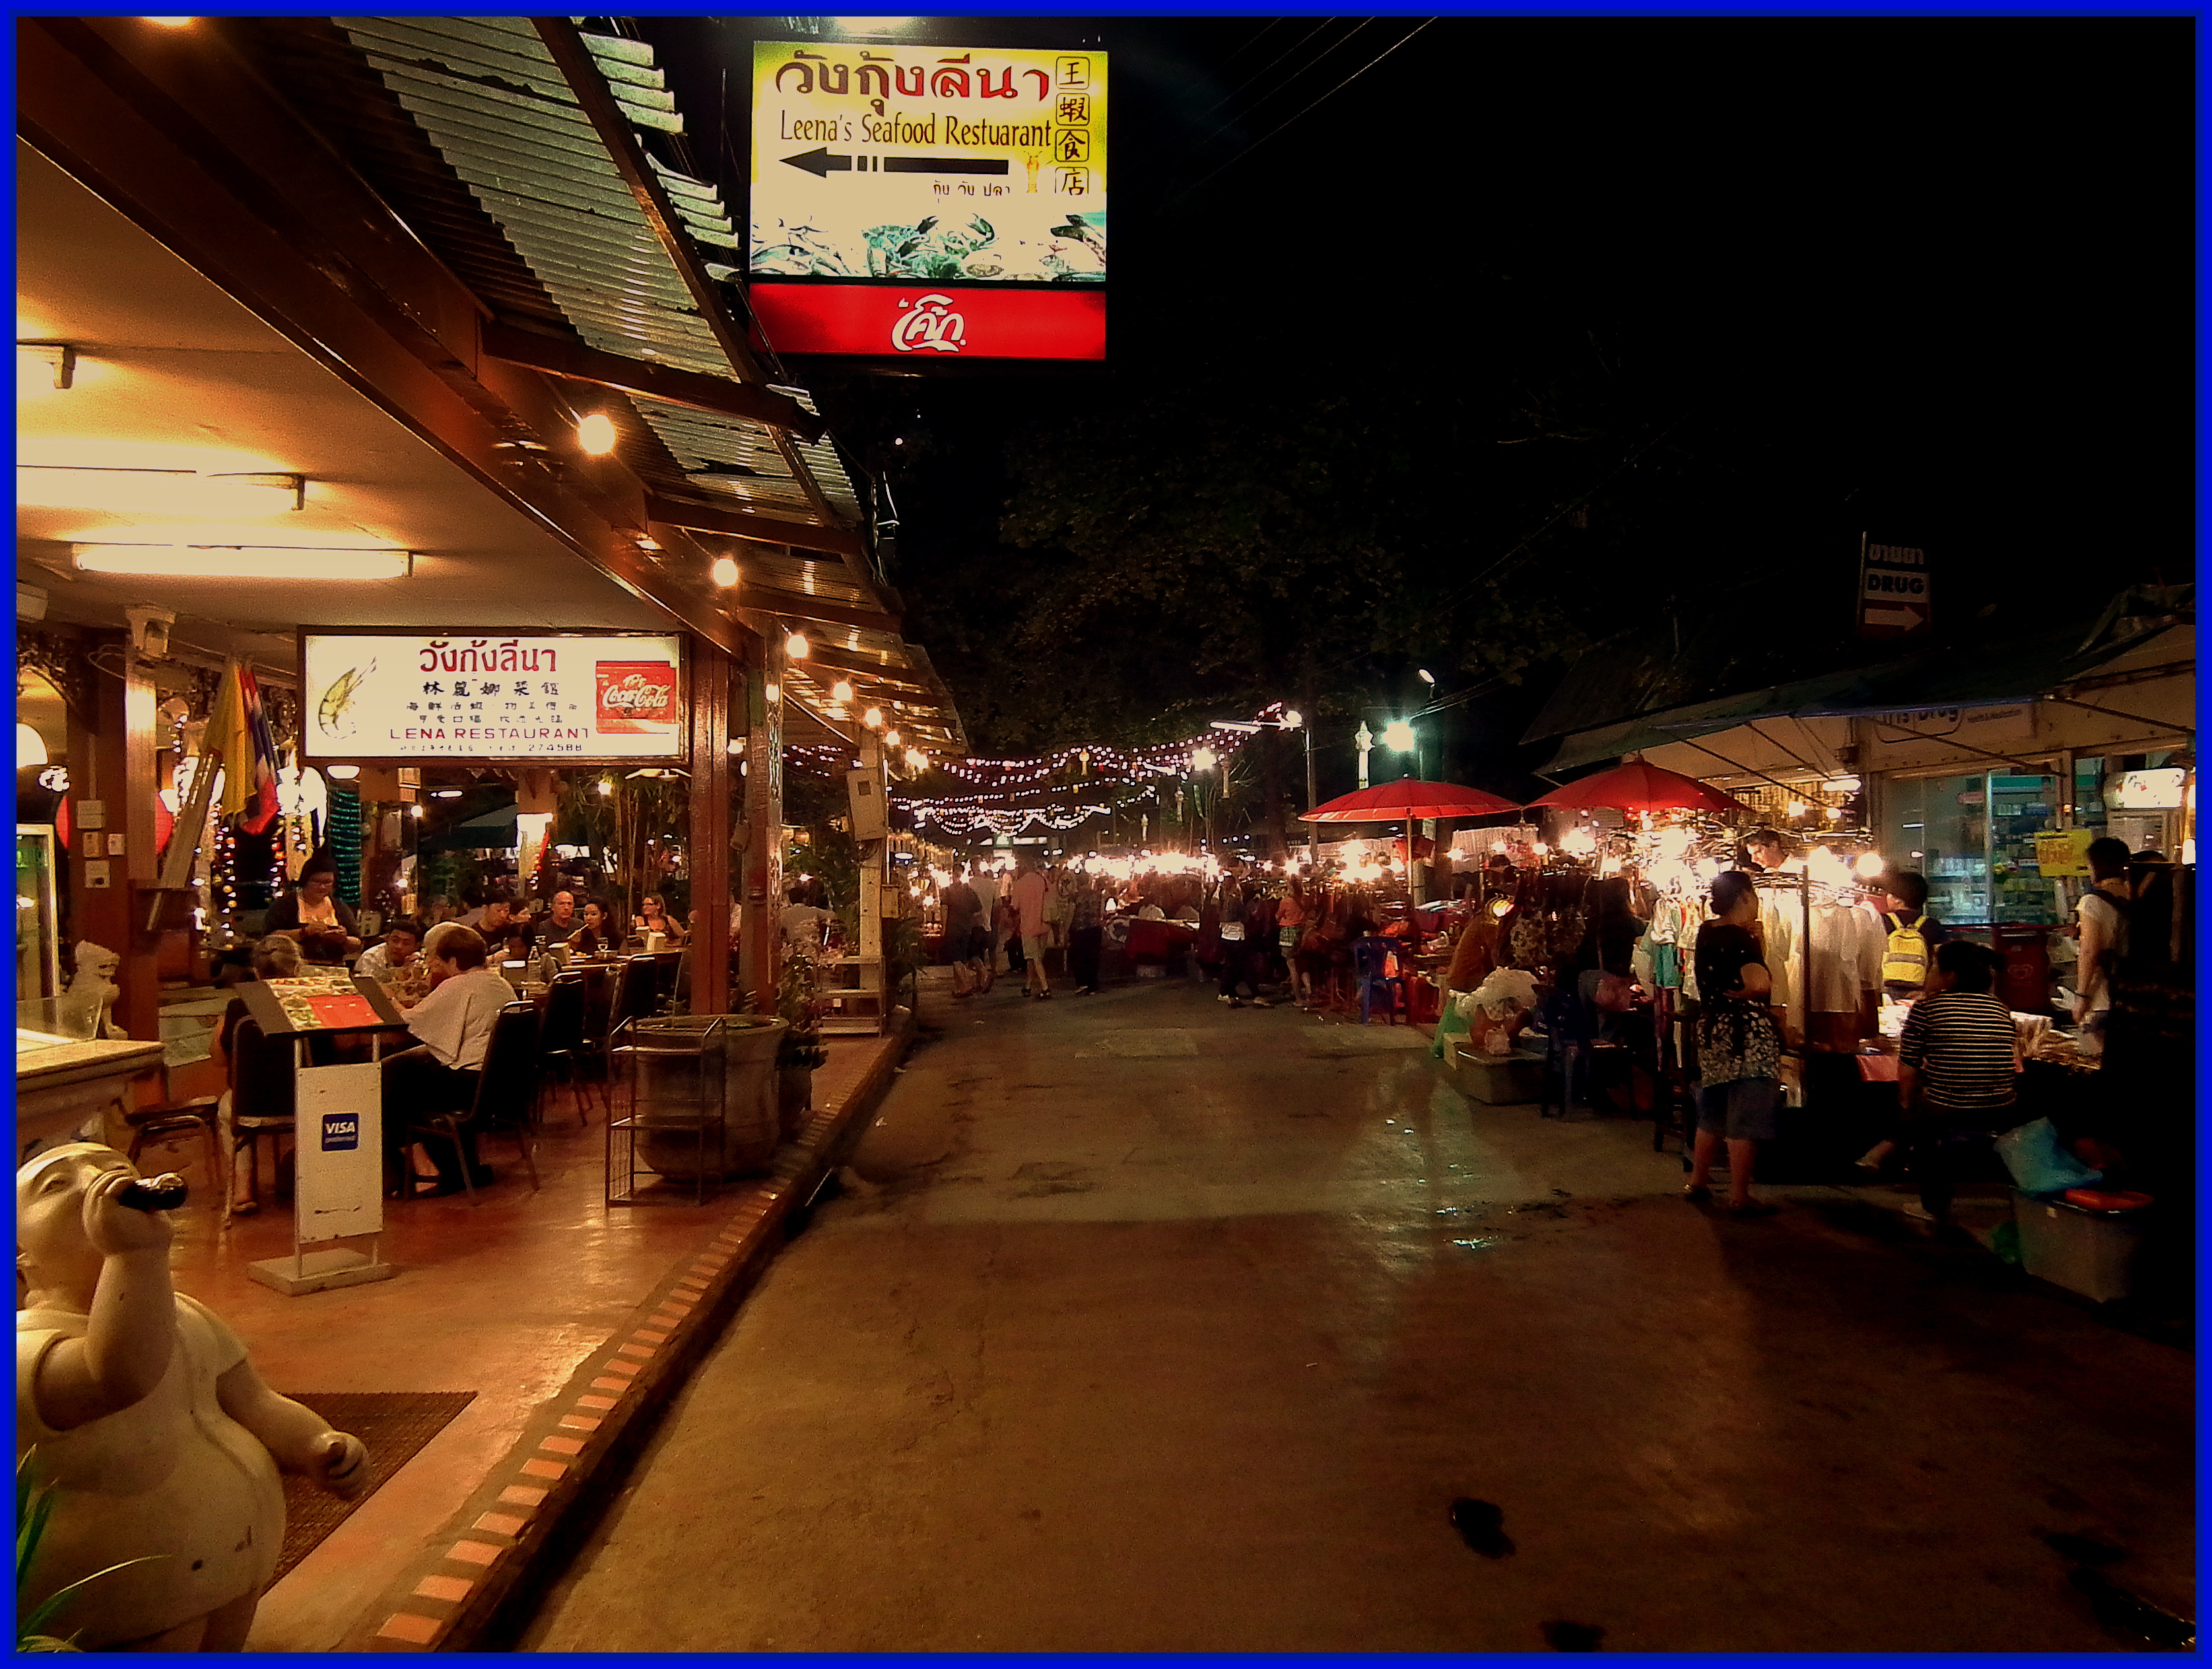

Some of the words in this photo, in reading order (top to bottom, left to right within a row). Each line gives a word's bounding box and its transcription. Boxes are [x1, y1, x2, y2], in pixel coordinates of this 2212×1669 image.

[776, 49, 1050, 117] วังกุ้งลีนา
[781, 110, 853, 142] Leena's
[861, 112, 936, 145] Seafood
[945, 115, 1052, 147] Restuarant
[1867, 573, 1924, 595] DRUG
[419, 639, 557, 681] วังก้งลีนา
[602, 684, 672, 709] Coca-Cola
[390, 728, 446, 739] LENA
[454, 727, 589, 739] RESTAURANT
[323, 1121, 356, 1134] VISA
